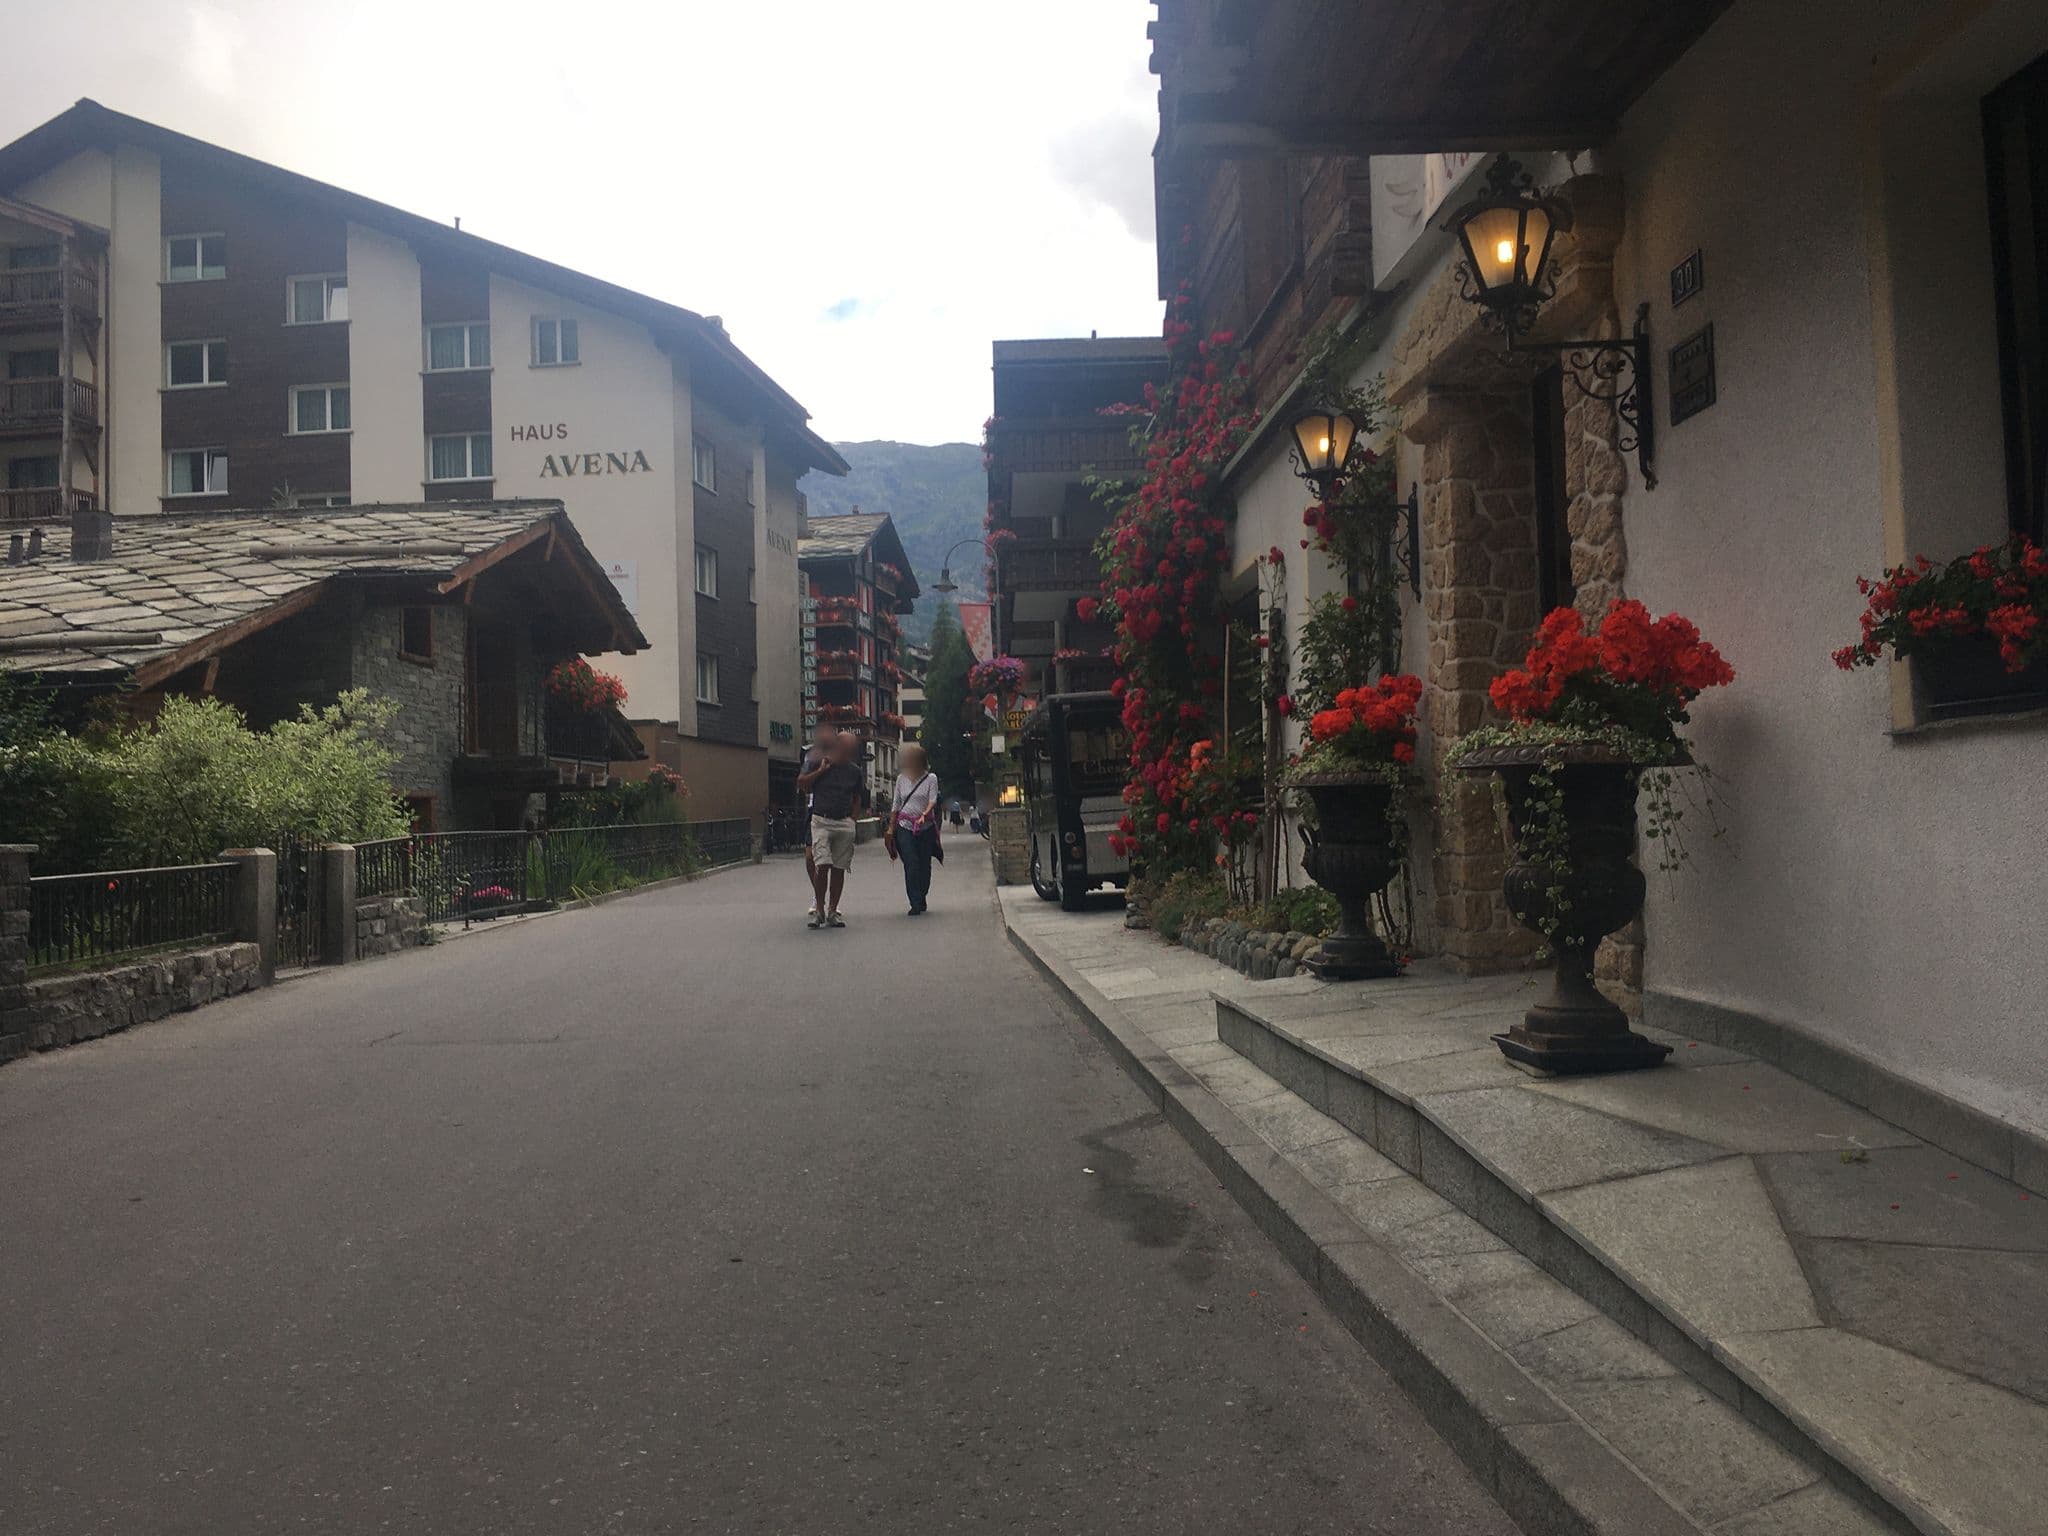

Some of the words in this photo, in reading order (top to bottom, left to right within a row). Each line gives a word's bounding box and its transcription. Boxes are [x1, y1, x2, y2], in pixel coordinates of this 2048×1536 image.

[1676, 262, 1693, 295] 30
[511, 423, 568, 441] HAUS
[539, 449, 654, 478] AVENA
